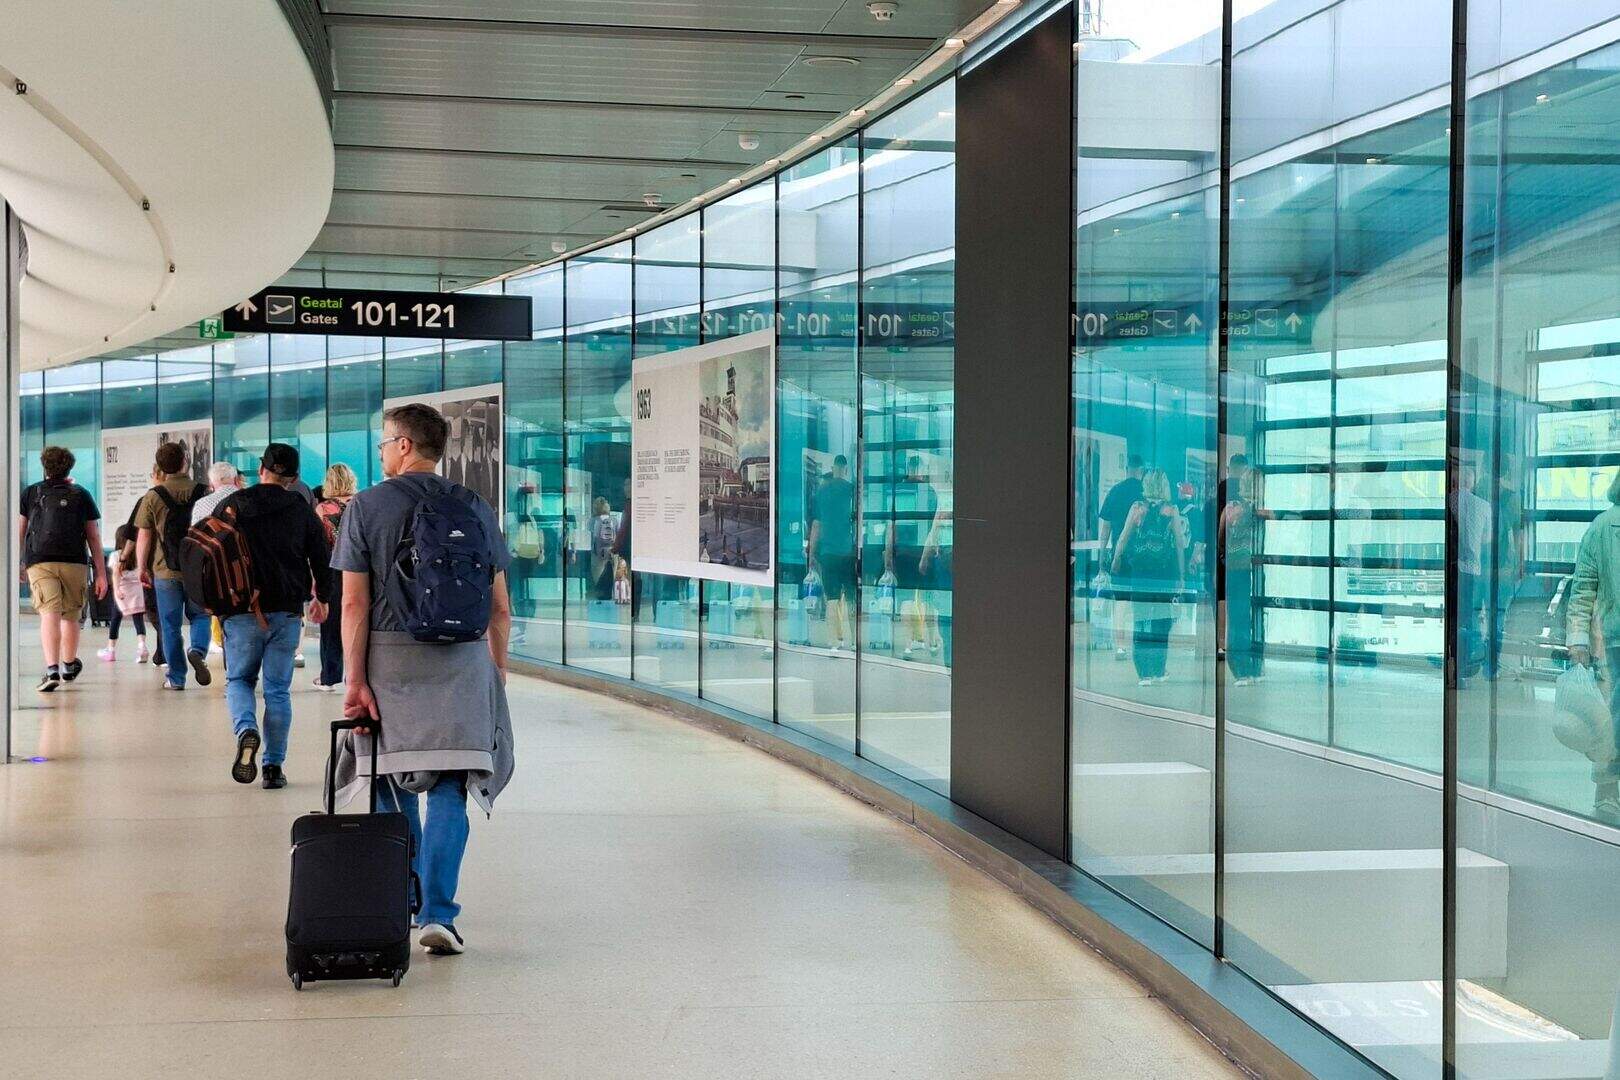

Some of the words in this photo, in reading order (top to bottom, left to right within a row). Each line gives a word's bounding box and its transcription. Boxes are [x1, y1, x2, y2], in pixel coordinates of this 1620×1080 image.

[300, 312, 338, 325] Gates
[351, 301, 455, 328] 101-121
[637, 389, 651, 419] 1963
[106, 446, 118, 462] 1972
